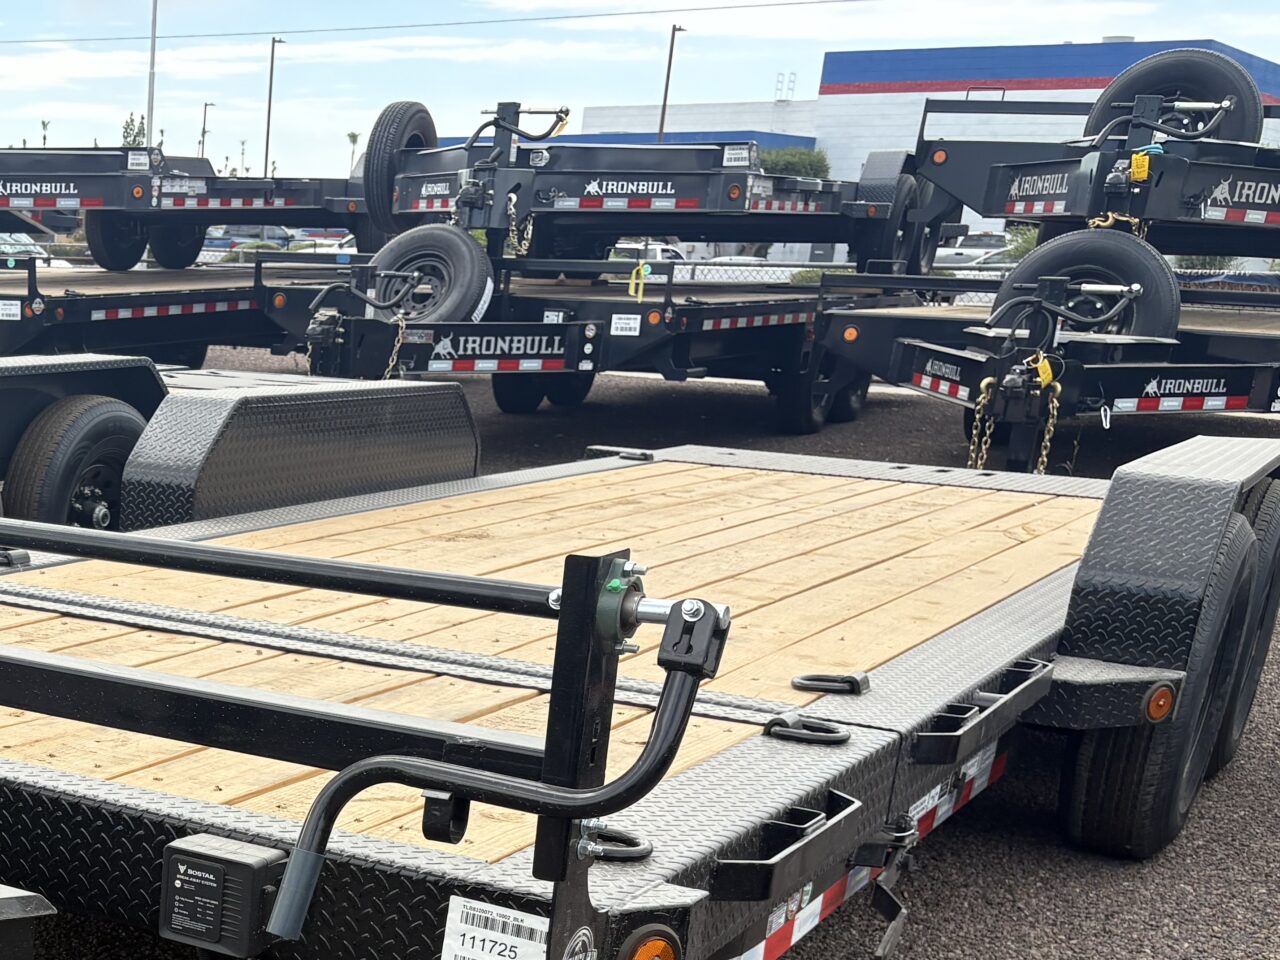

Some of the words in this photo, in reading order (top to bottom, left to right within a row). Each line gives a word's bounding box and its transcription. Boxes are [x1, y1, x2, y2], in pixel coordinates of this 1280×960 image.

[6, 183, 78, 194] IRONBULL
[602, 181, 675, 194] IRONBULL
[1019, 173, 1069, 196] IRONBULL
[458, 336, 564, 355] IRONBULL
[1160, 379, 1227, 394] IRONBULL
[460, 933, 519, 960] 111725
